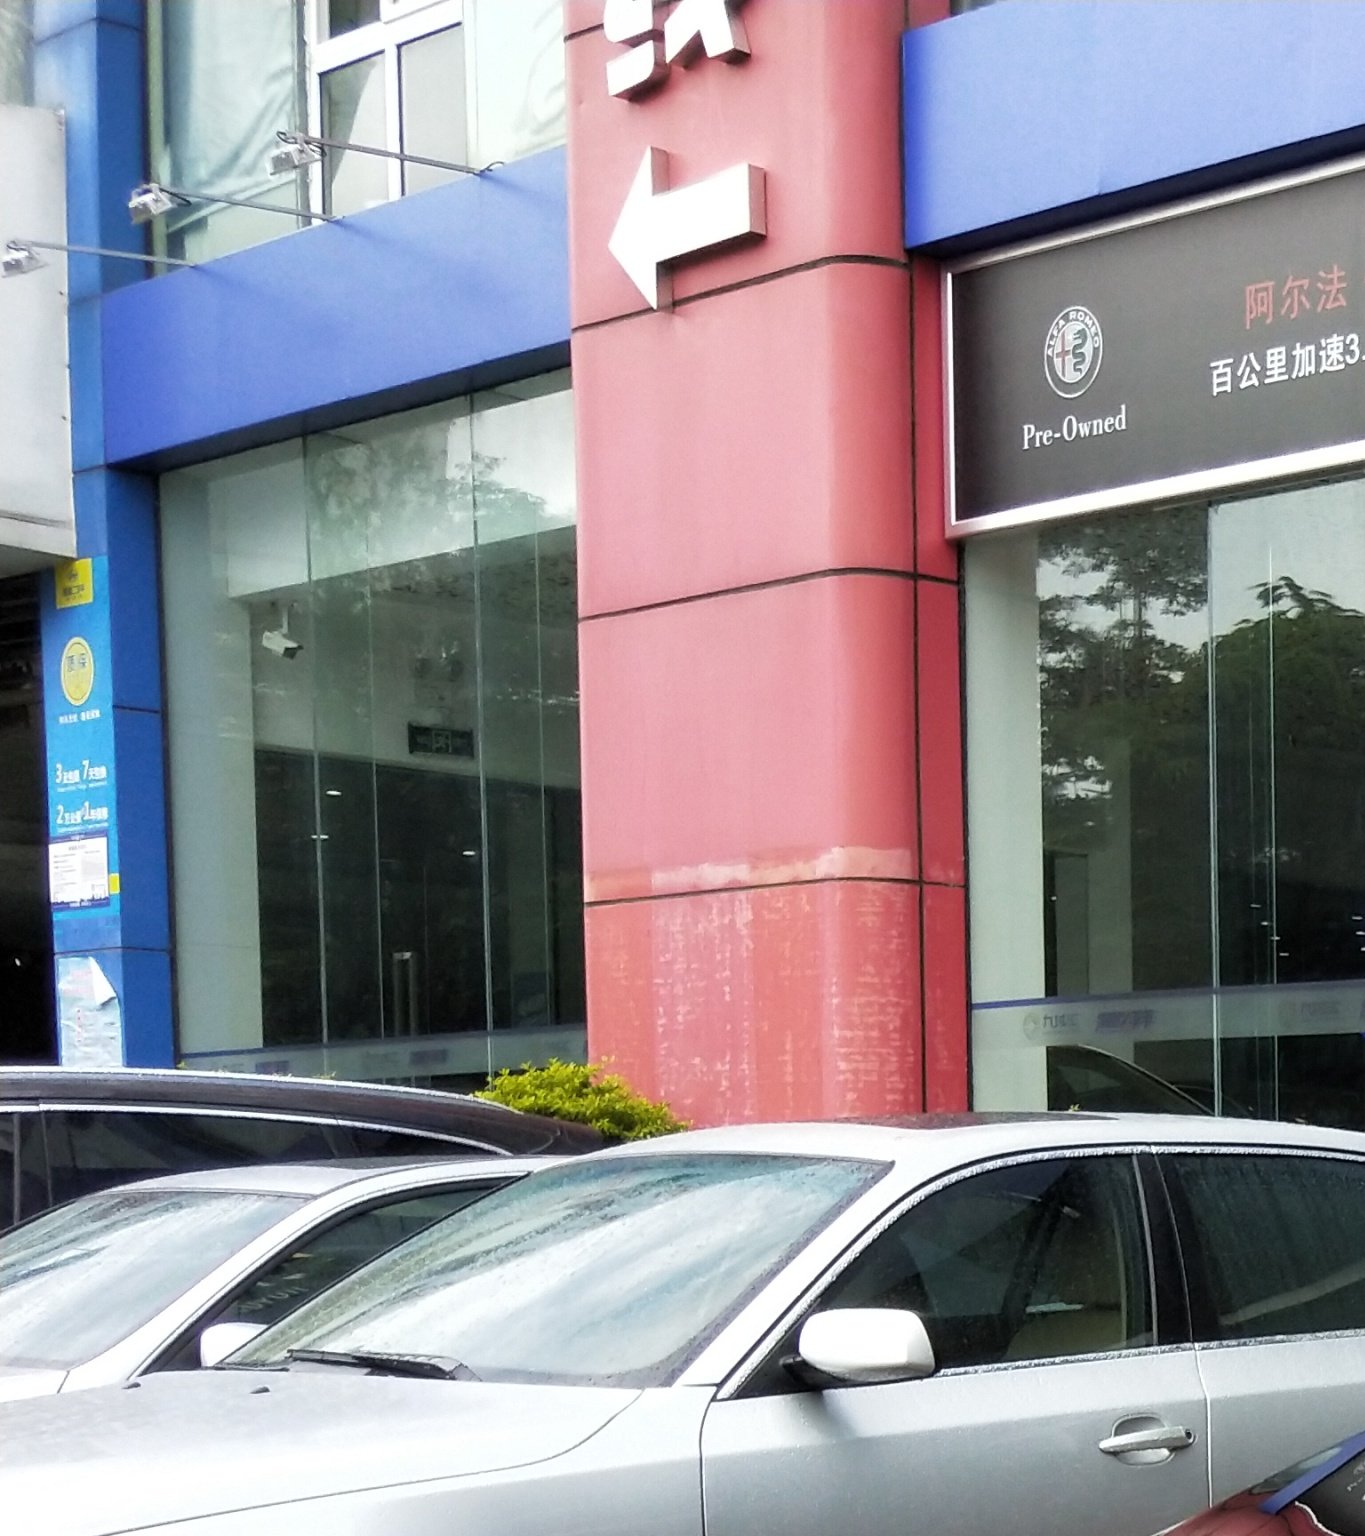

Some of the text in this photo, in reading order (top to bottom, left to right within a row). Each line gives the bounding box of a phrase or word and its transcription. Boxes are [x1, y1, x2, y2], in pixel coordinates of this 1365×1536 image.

[1047, 310, 1100, 357] ALFA ROMEO
[1022, 404, 1127, 450] Pre-Owned
